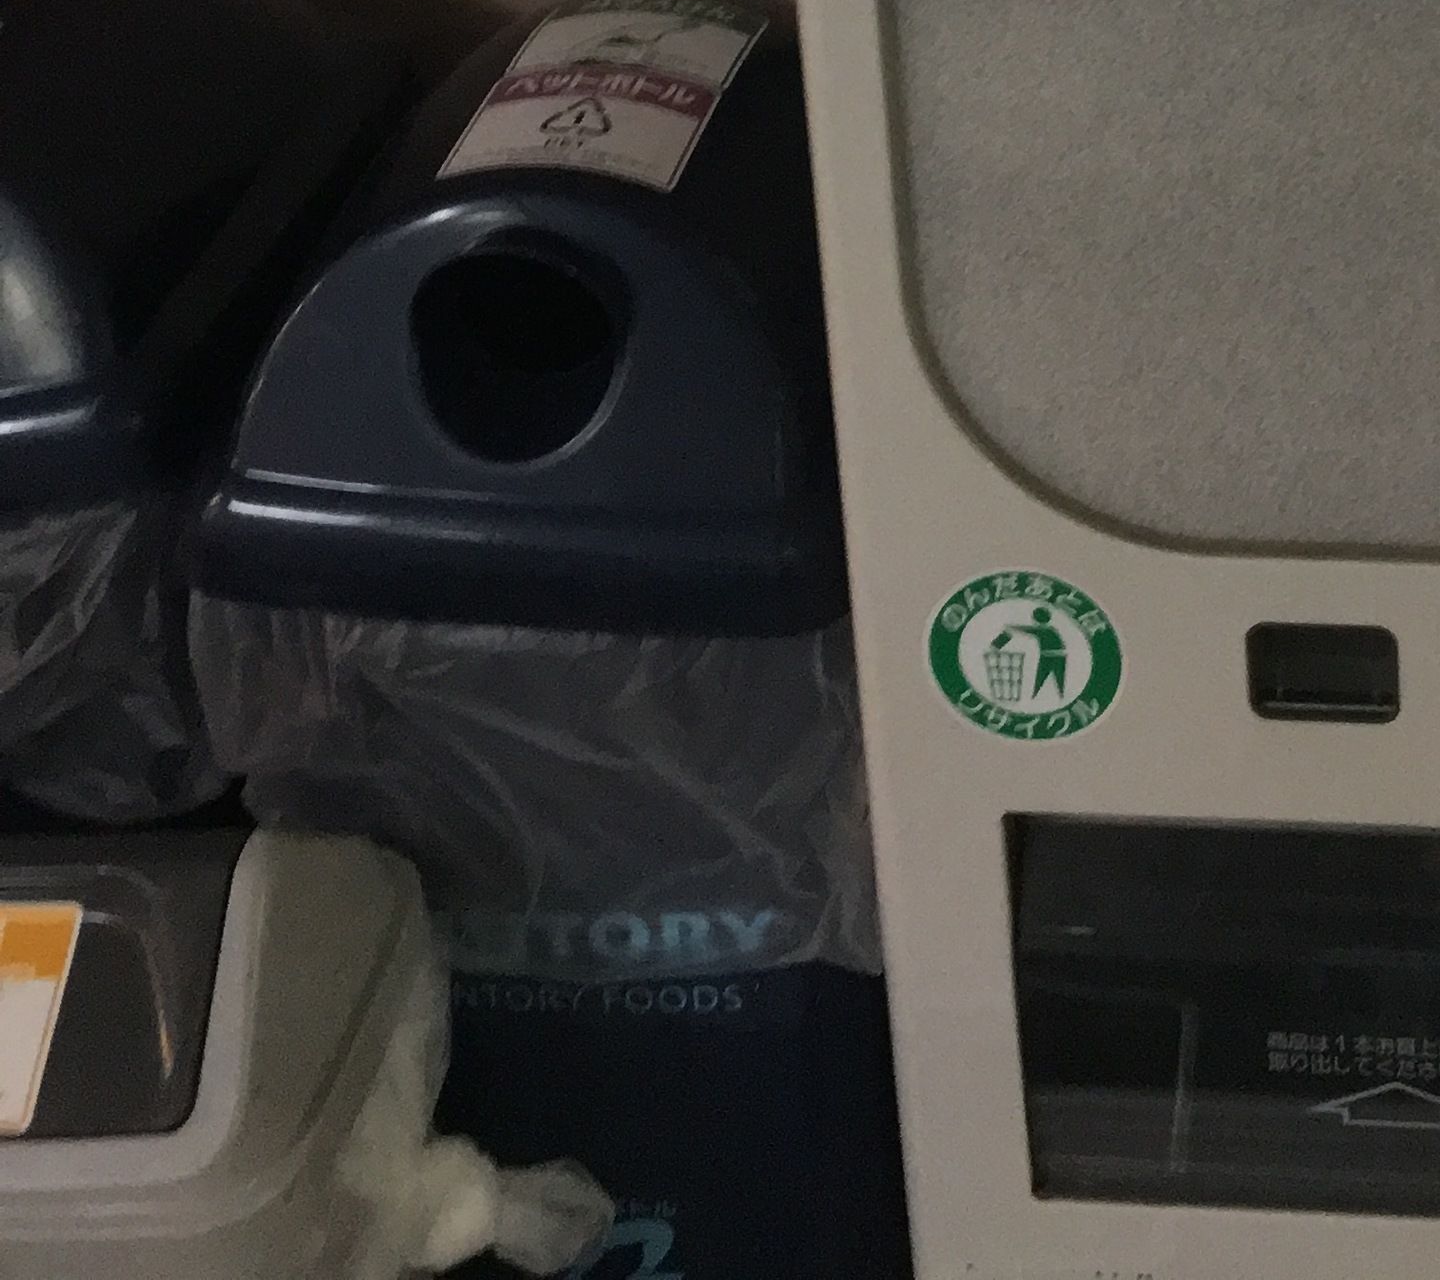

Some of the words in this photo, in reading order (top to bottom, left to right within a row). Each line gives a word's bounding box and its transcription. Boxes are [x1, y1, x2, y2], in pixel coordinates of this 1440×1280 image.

[958, 688, 1100, 739] リサイクル
[600, 983, 744, 1015] FOODS
